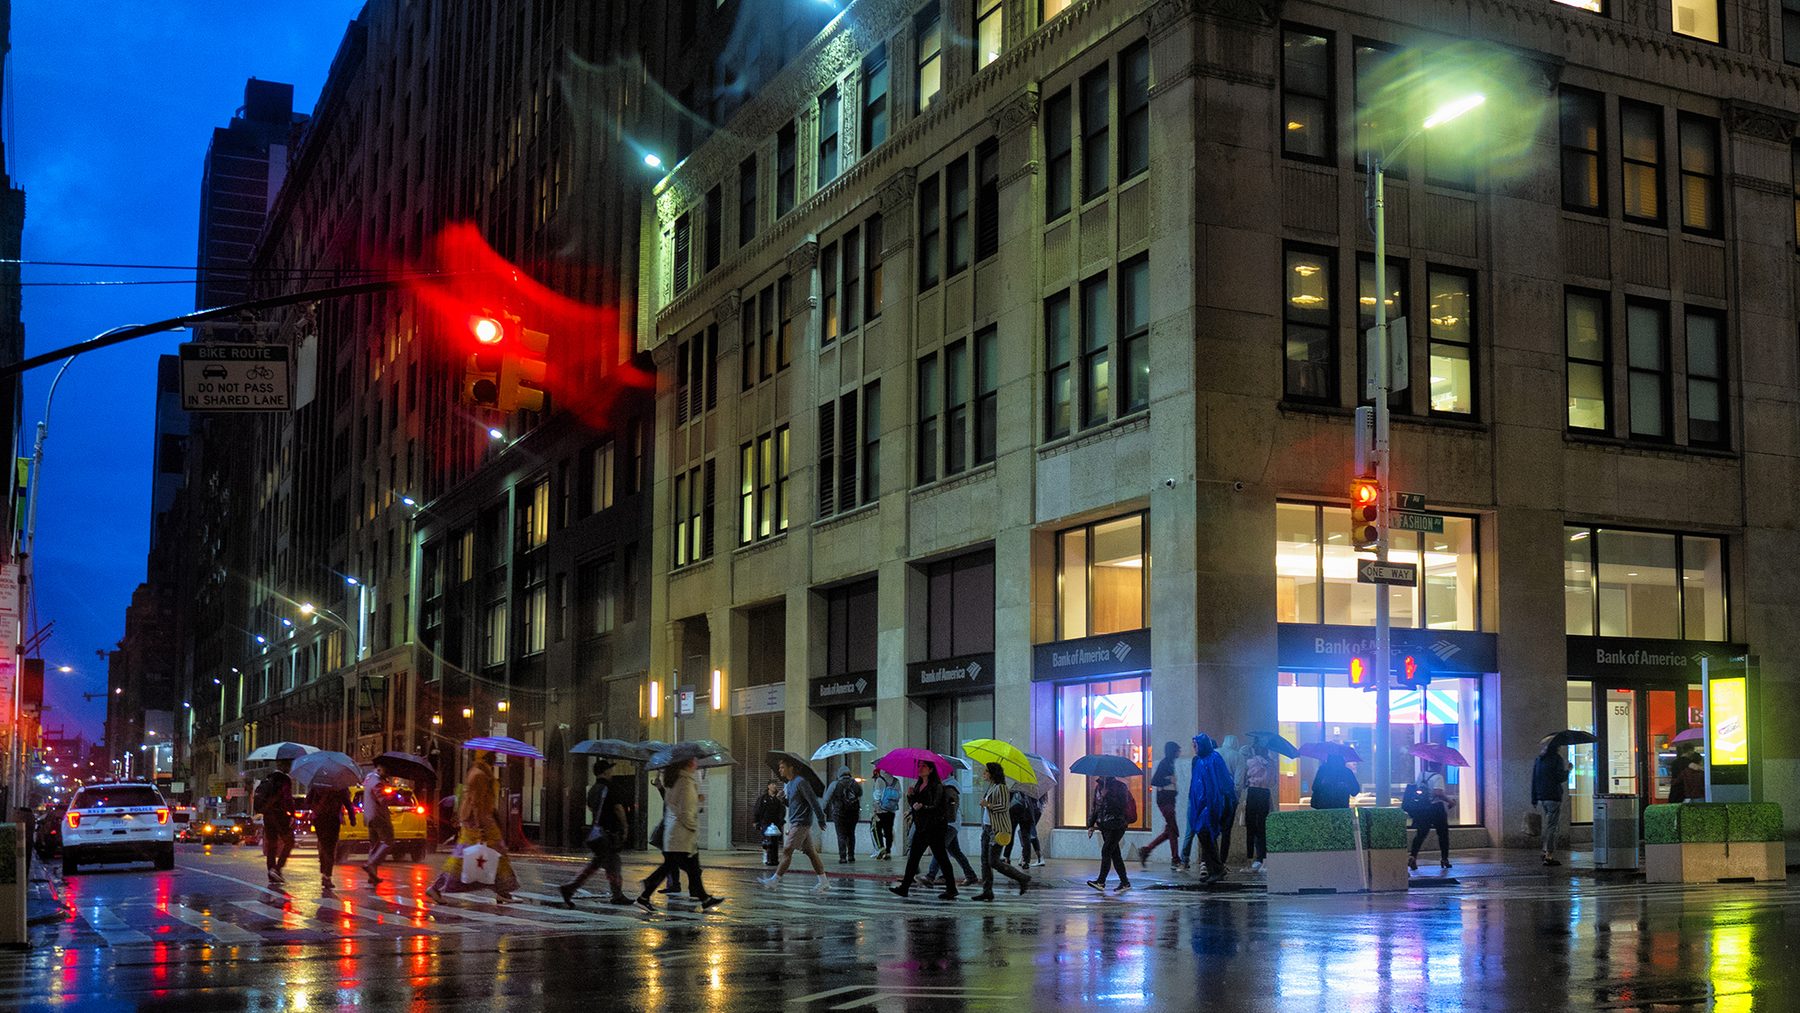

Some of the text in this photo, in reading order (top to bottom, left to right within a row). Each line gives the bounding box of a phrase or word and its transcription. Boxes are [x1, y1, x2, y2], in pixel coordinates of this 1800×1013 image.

[199, 348, 271, 359] BIKE ROUTE
[198, 383, 274, 393] DO NOT PASS
[188, 395, 284, 405] IN SHARED LANE
[1401, 494, 1409, 507] 7
[1399, 514, 1434, 530] FASHION
[1366, 566, 1410, 579] ONE WAY
[1314, 637, 1350, 654] Bank
[1052, 647, 1110, 668] Bank of America
[1596, 648, 1687, 666] Bank of America
[921, 665, 966, 684] Bank of America
[820, 684, 832, 697] Bank
[837, 681, 855, 694] America
[1614, 705, 1630, 716] 550
